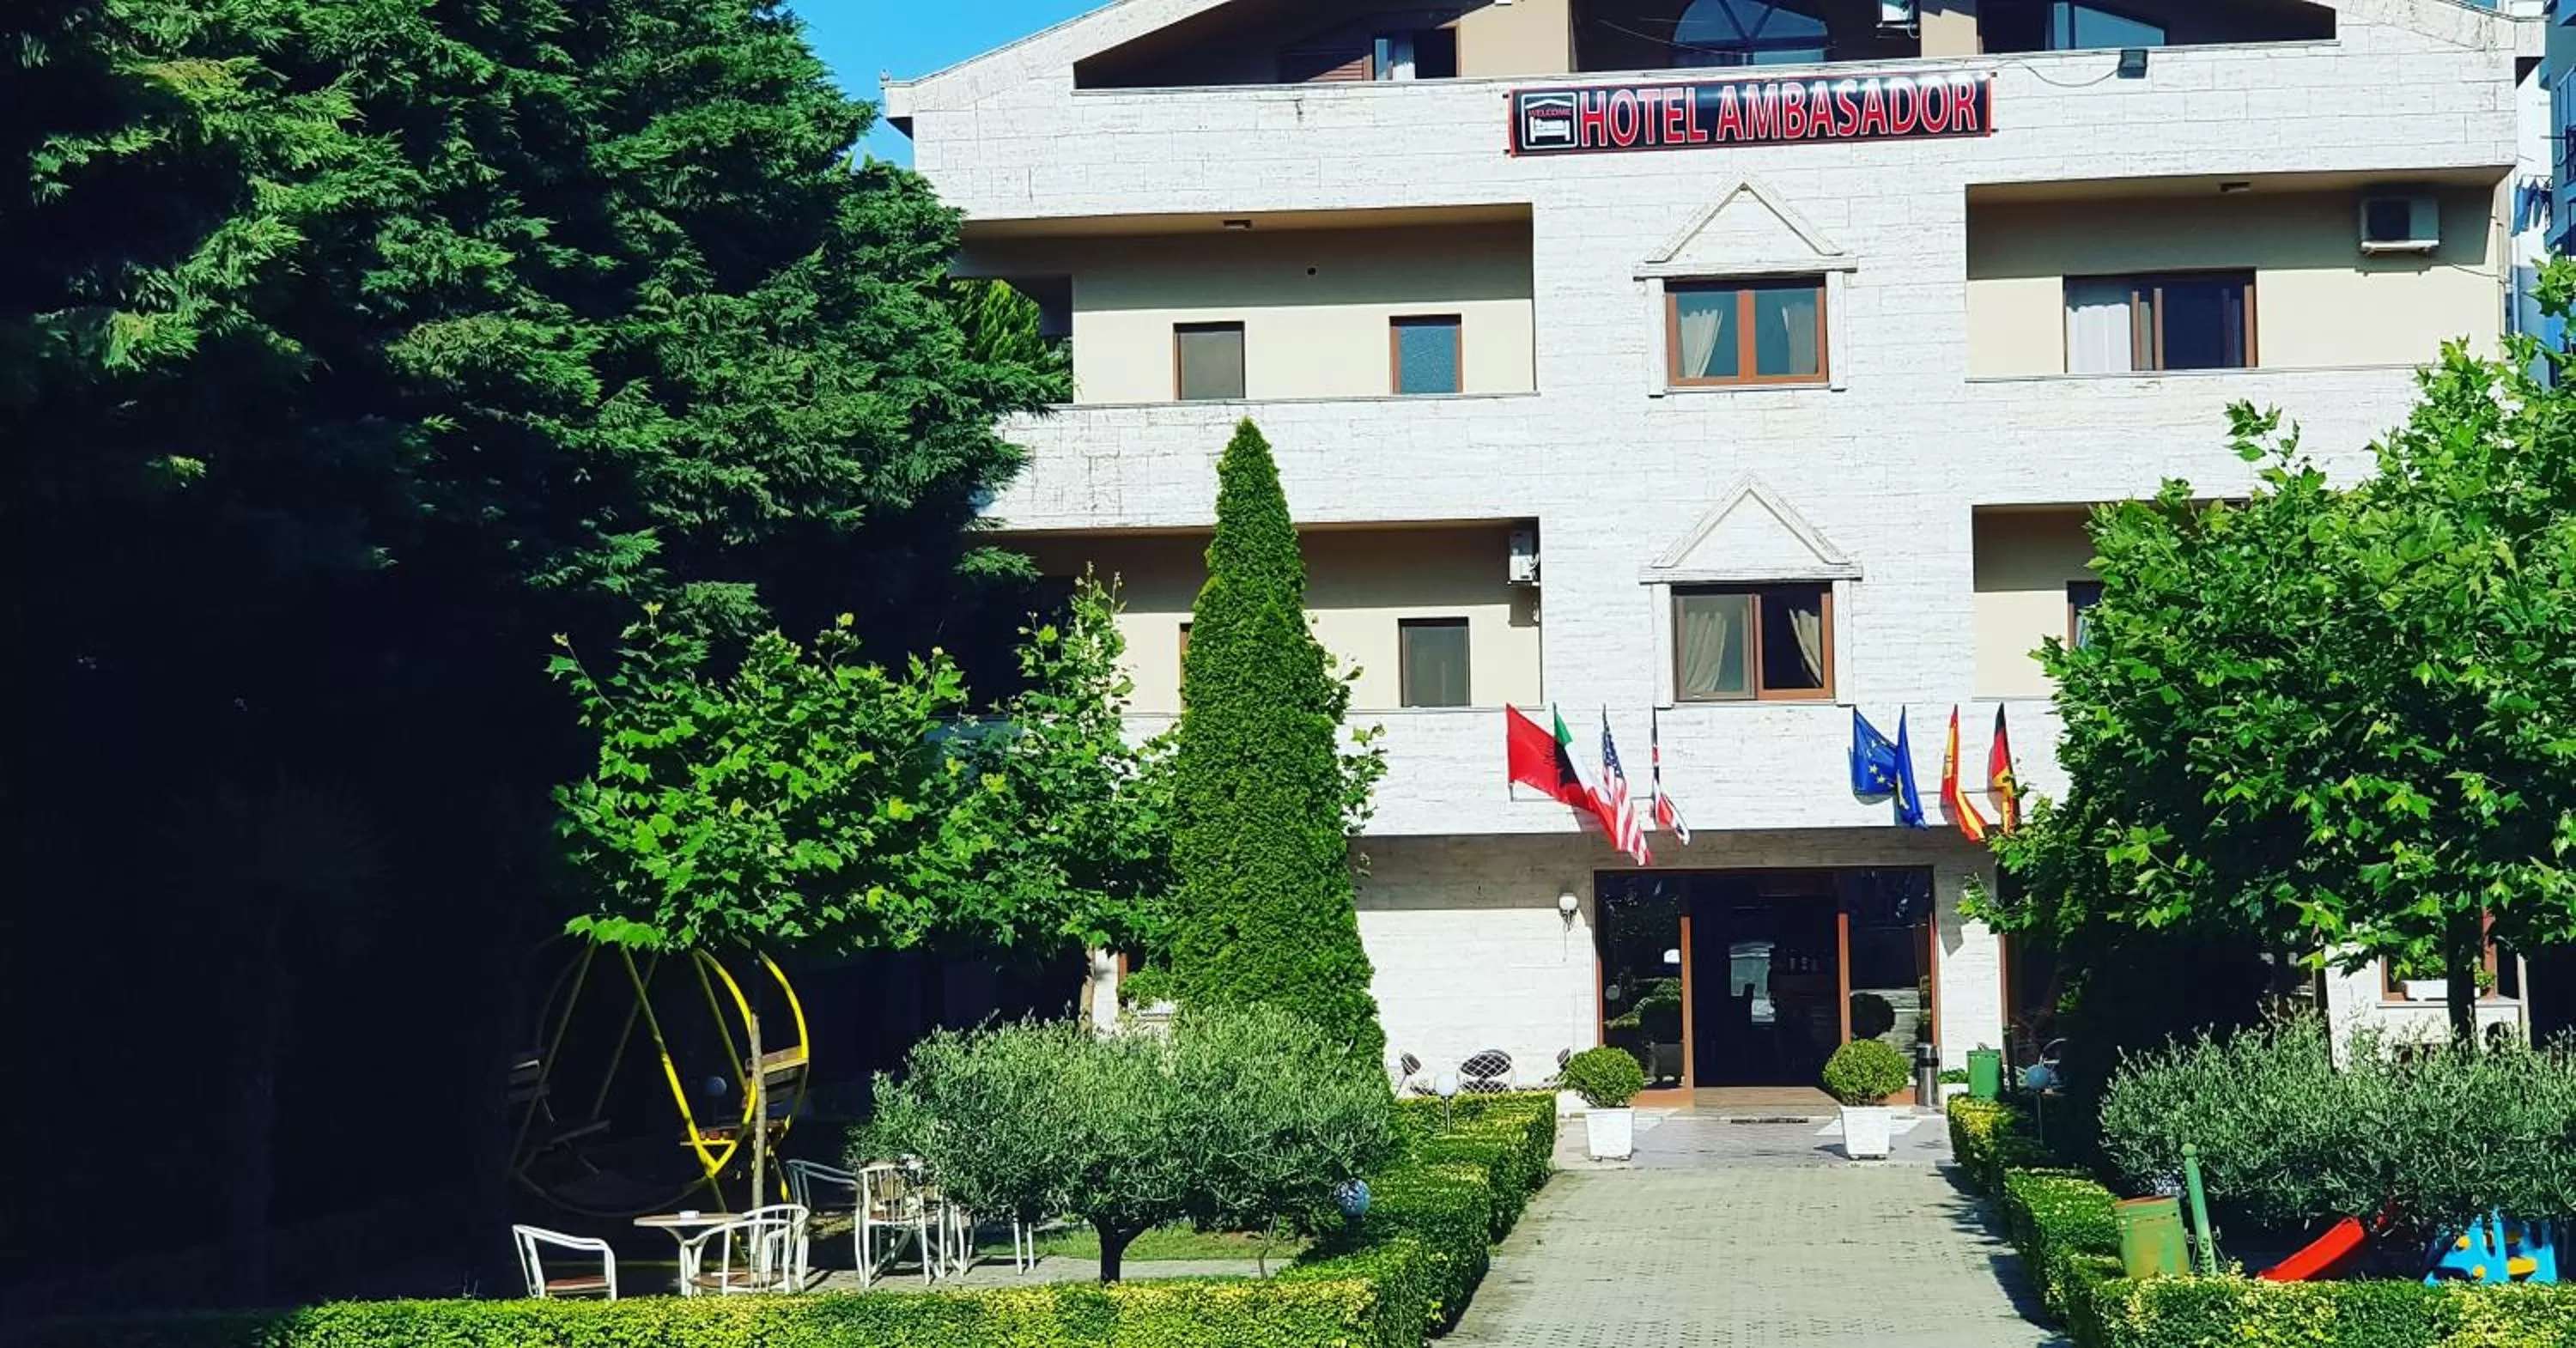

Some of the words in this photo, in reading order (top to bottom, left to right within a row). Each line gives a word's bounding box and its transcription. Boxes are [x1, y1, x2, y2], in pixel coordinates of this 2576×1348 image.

[1528, 107, 1572, 118] WELCOME
[1580, 88, 1708, 146] HOTEL
[1716, 74, 1978, 141] AMBASADOR
